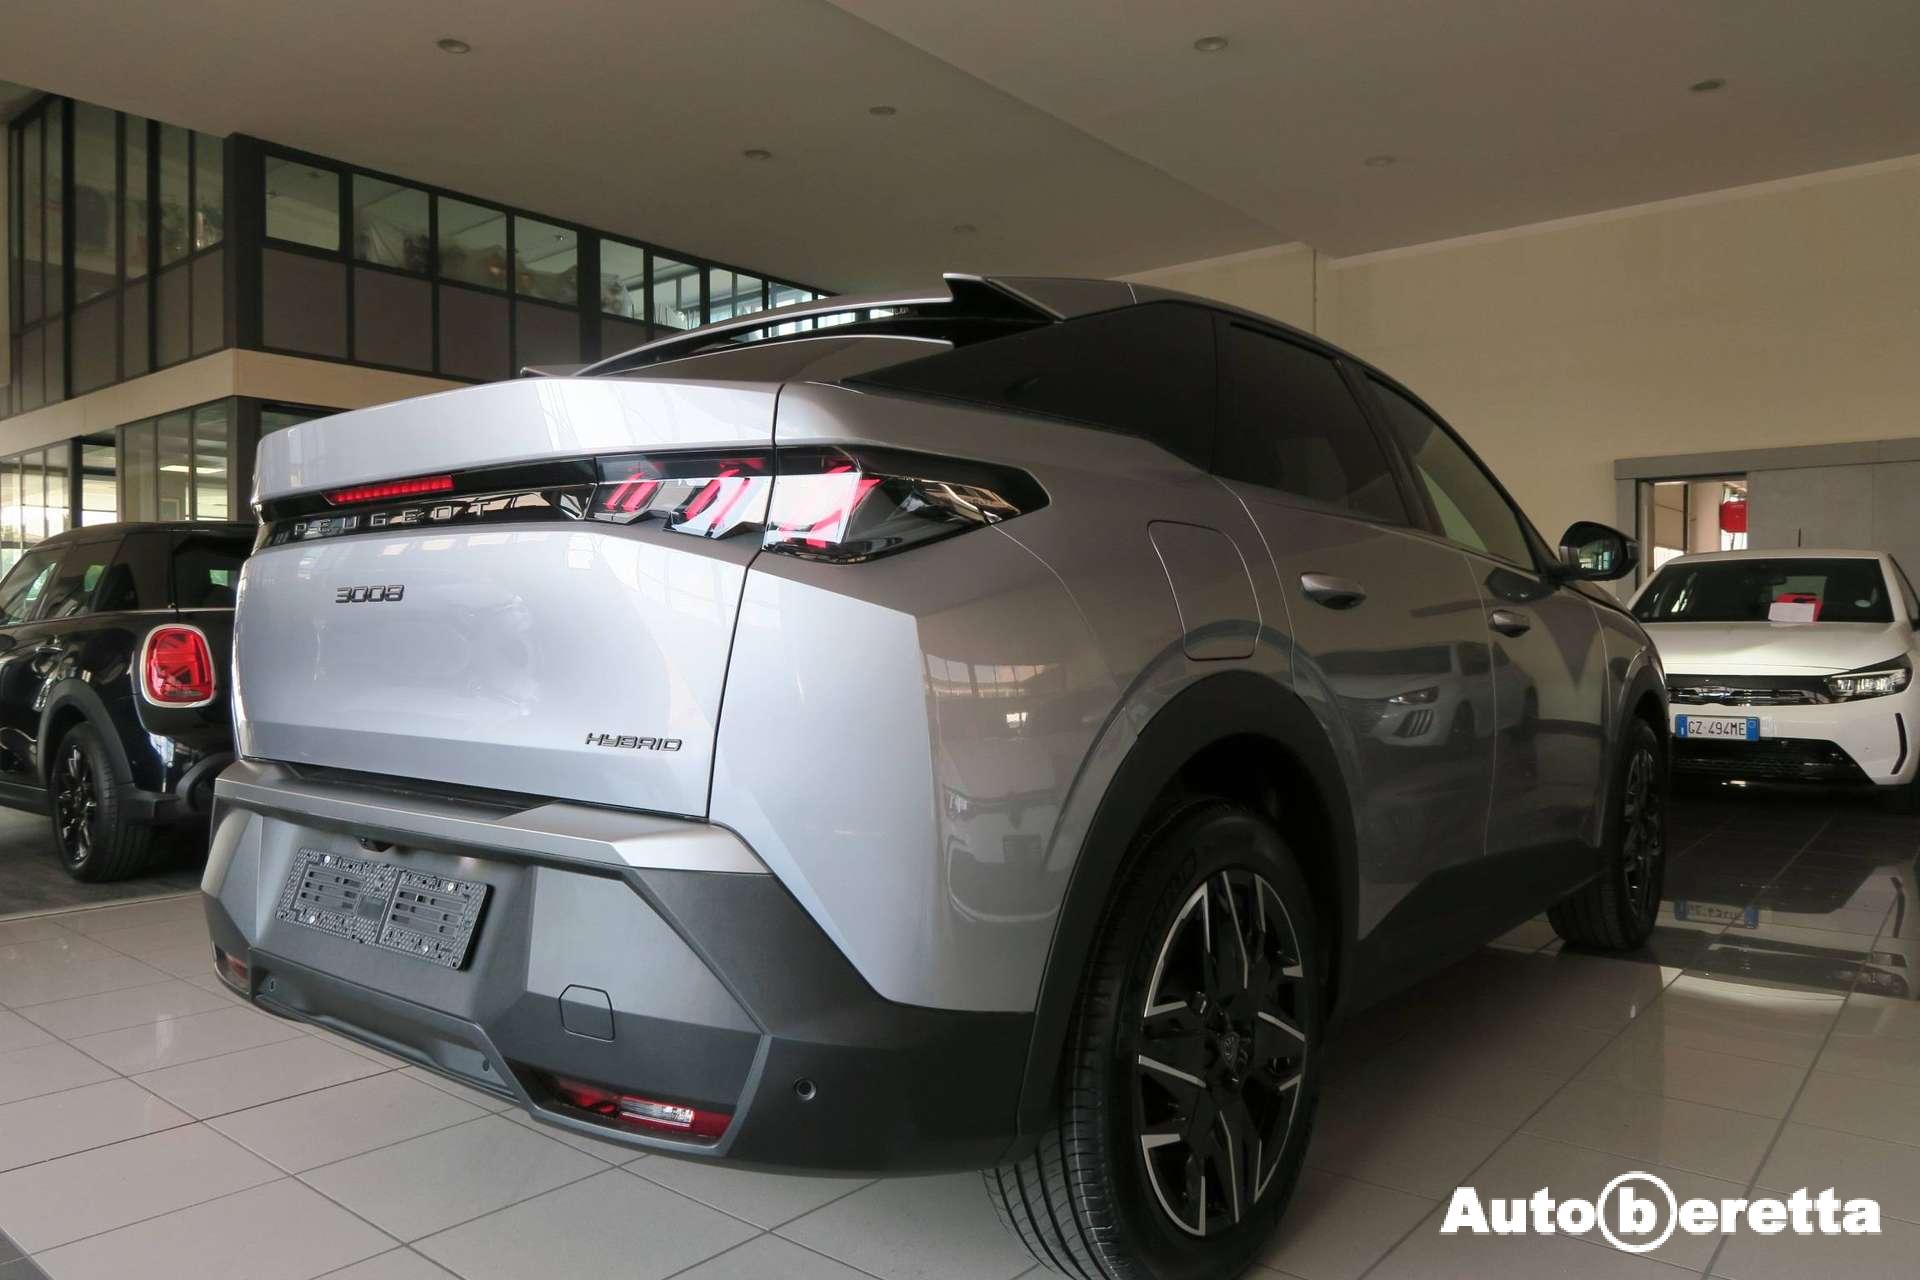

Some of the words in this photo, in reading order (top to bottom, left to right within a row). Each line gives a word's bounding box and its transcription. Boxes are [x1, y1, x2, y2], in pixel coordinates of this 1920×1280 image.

[295, 502, 489, 537] PEUGEOT
[335, 585, 405, 604] 3008
[585, 732, 683, 752] HYBRID
